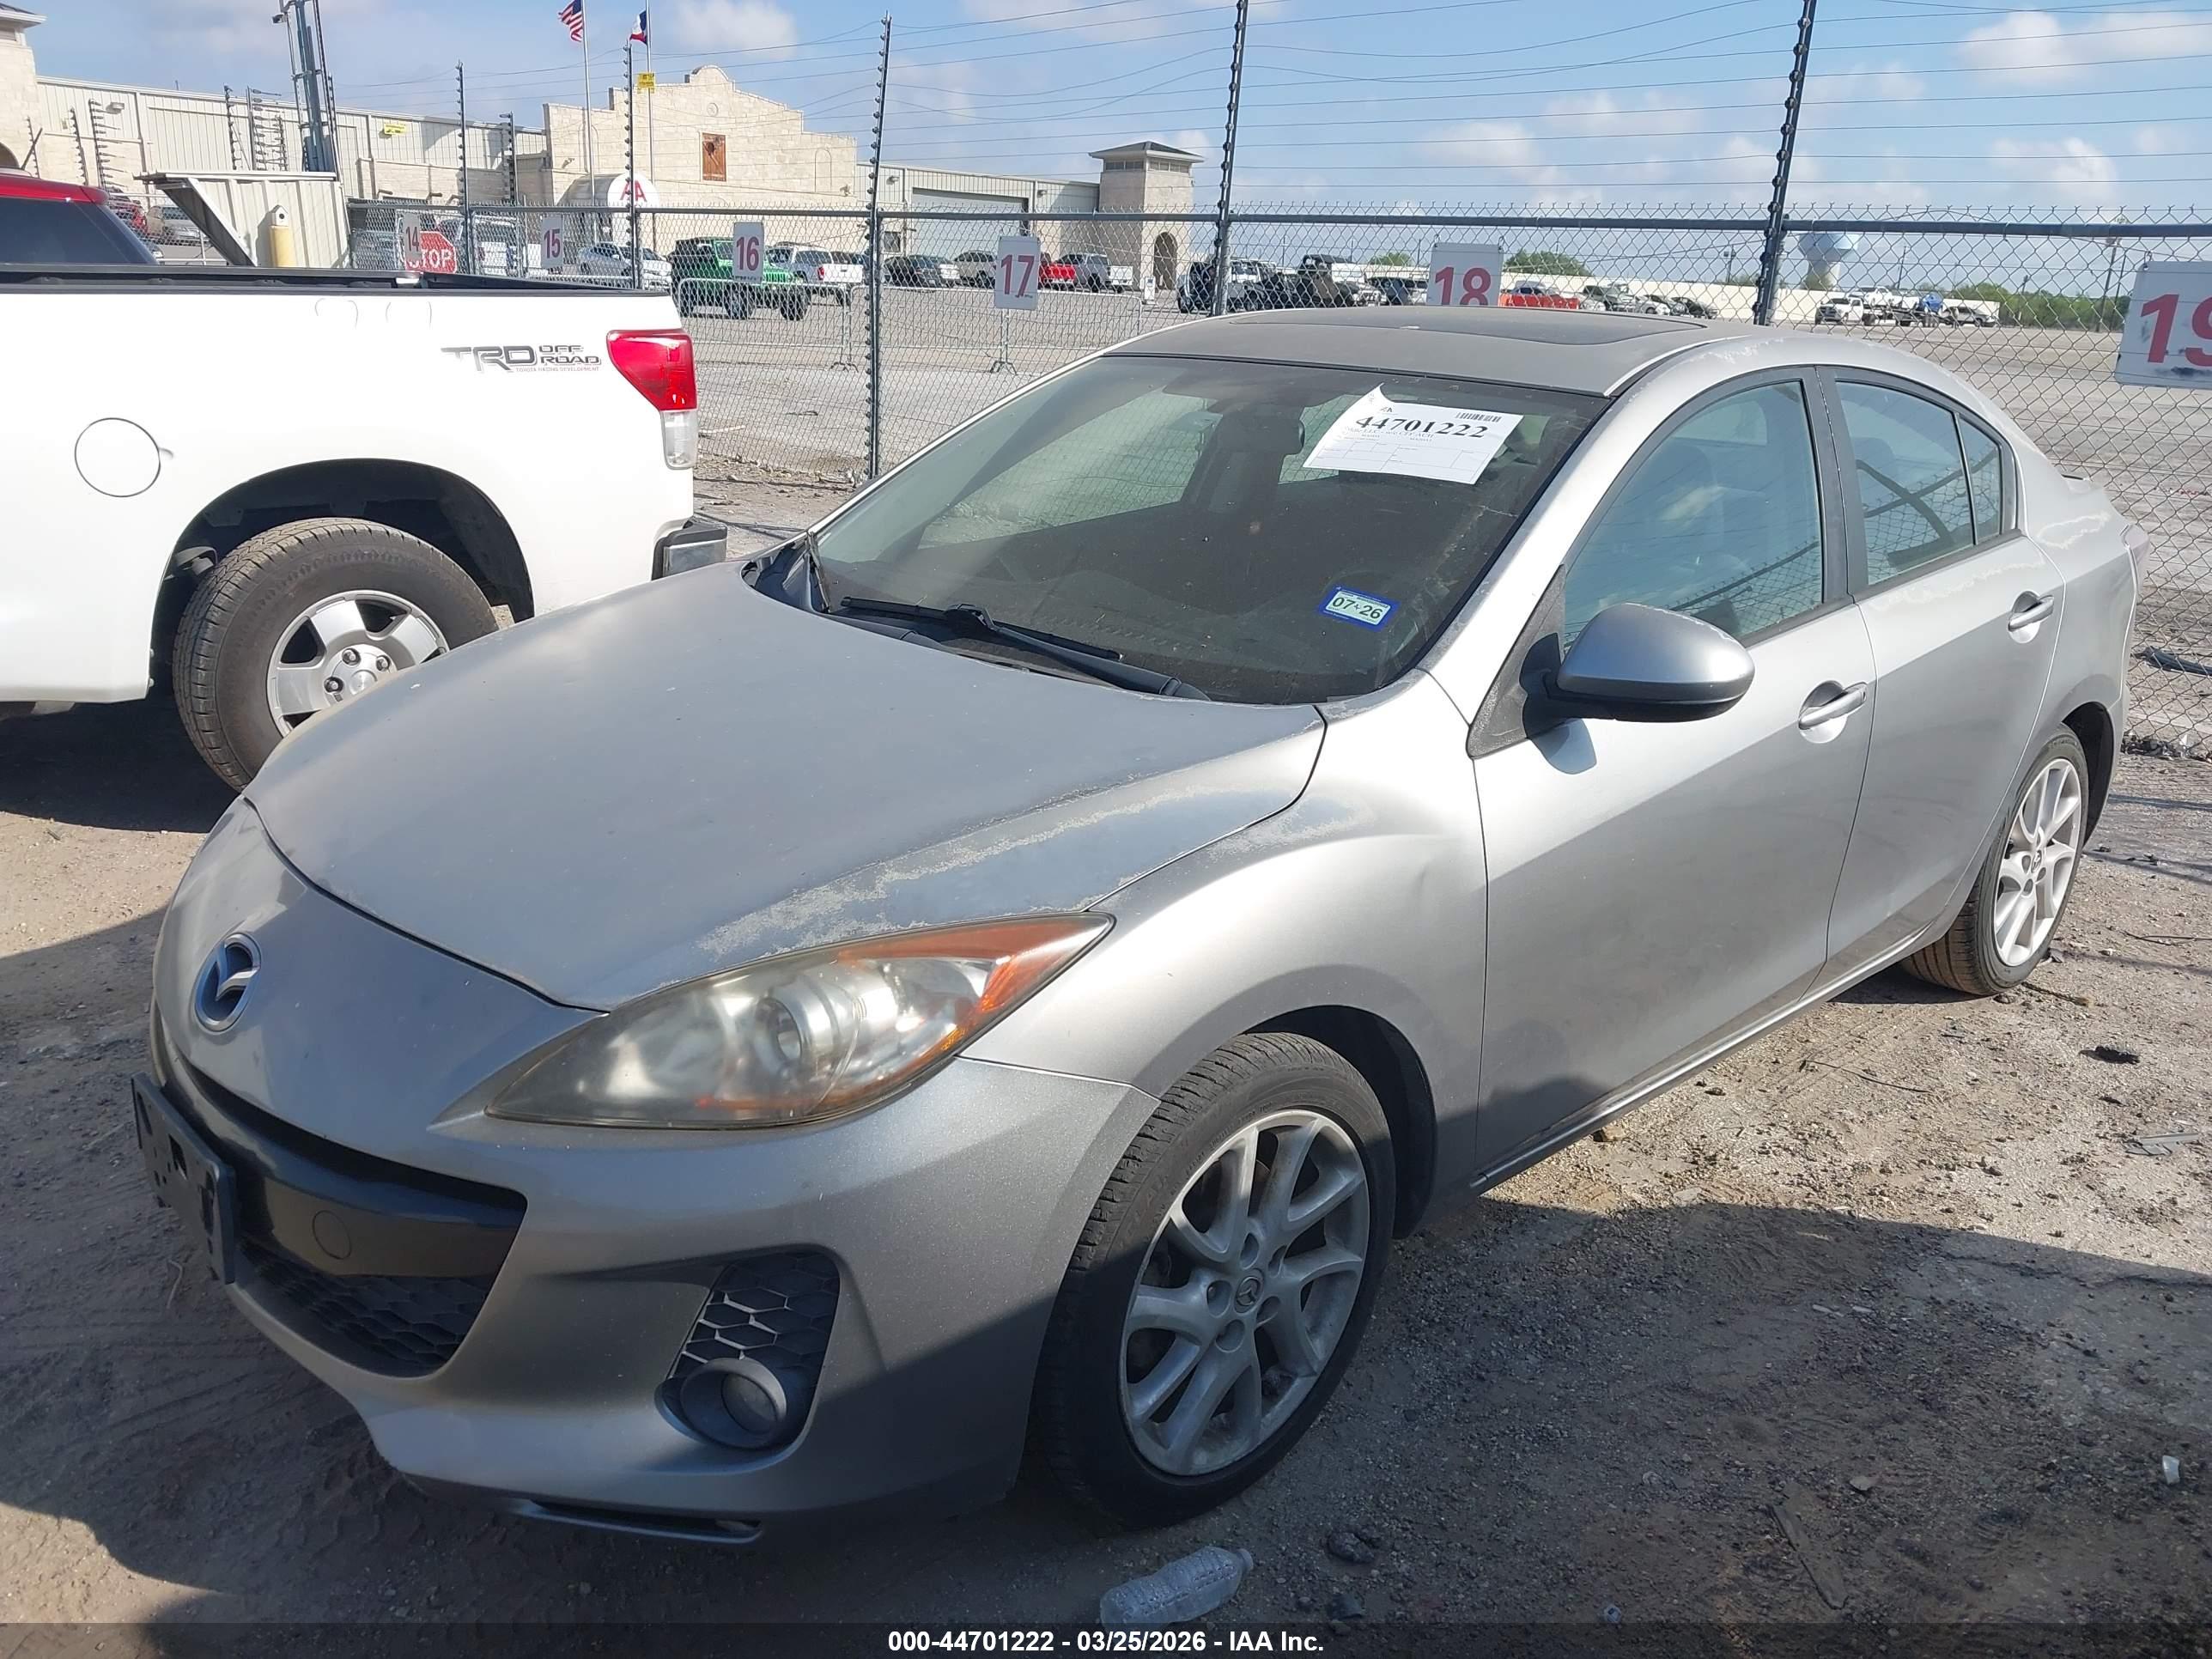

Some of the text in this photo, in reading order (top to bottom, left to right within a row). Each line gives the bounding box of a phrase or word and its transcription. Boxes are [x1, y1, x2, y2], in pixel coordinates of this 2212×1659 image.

[405, 226, 420, 252] 14
[544, 228, 561, 258] 15
[736, 236, 760, 271] 16
[1000, 254, 1035, 297] 17
[1435, 266, 1492, 306] 18
[2141, 294, 2212, 367] 19
[441, 345, 538, 372] TRD
[538, 344, 584, 355] OFF
[540, 356, 601, 366] ROAD
[1356, 416, 1488, 439] 44701222
[1332, 597, 1355, 610] 07
[1359, 605, 1383, 619] 26
